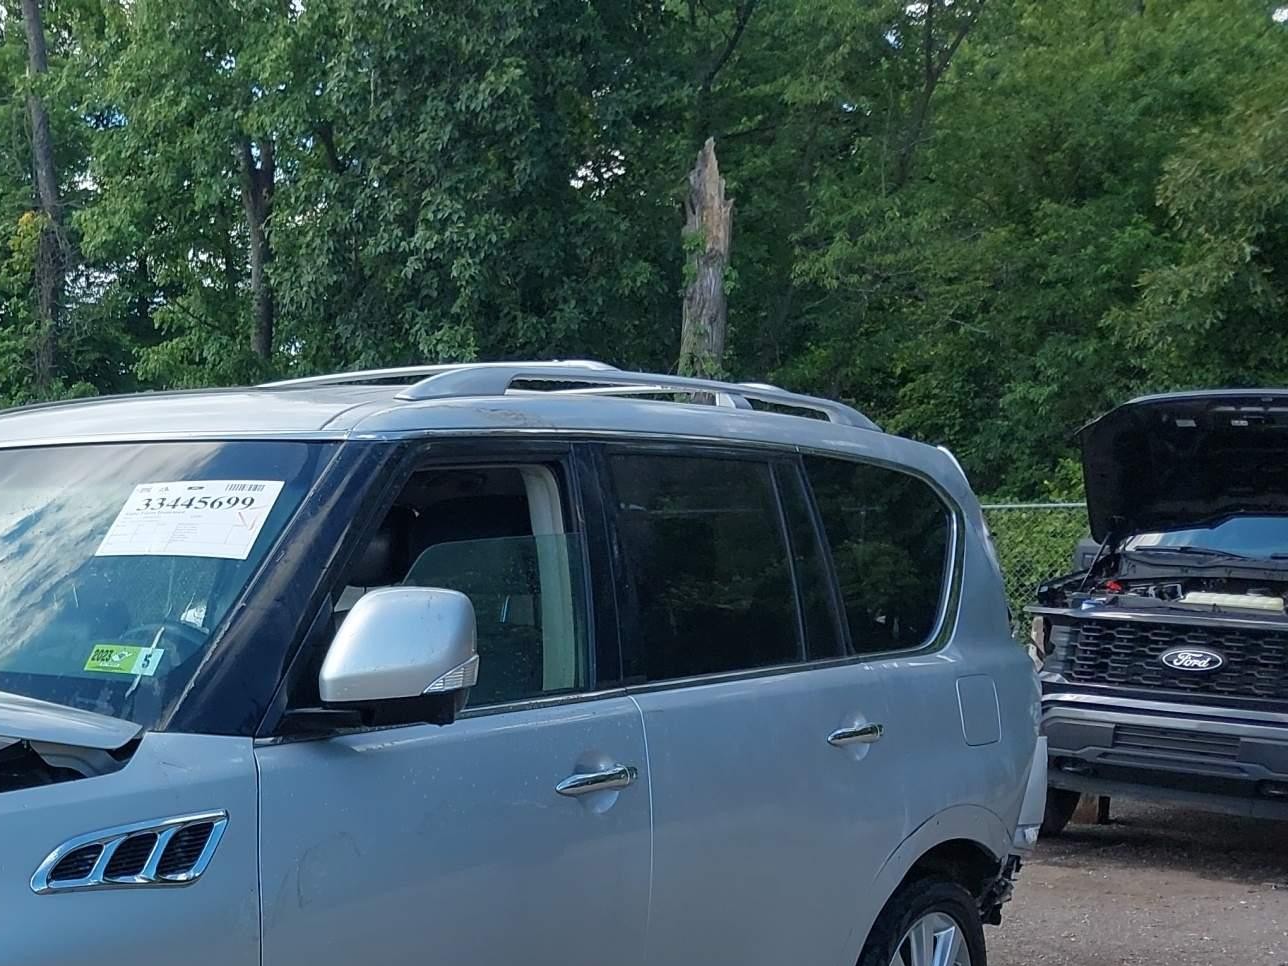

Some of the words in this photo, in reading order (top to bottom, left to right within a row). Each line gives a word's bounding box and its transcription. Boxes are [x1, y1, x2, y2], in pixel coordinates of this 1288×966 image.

[136, 495, 255, 512] 33445699
[91, 648, 115, 662] 2023
[141, 653, 153, 669] 5
[1172, 652, 1212, 668] Ford
